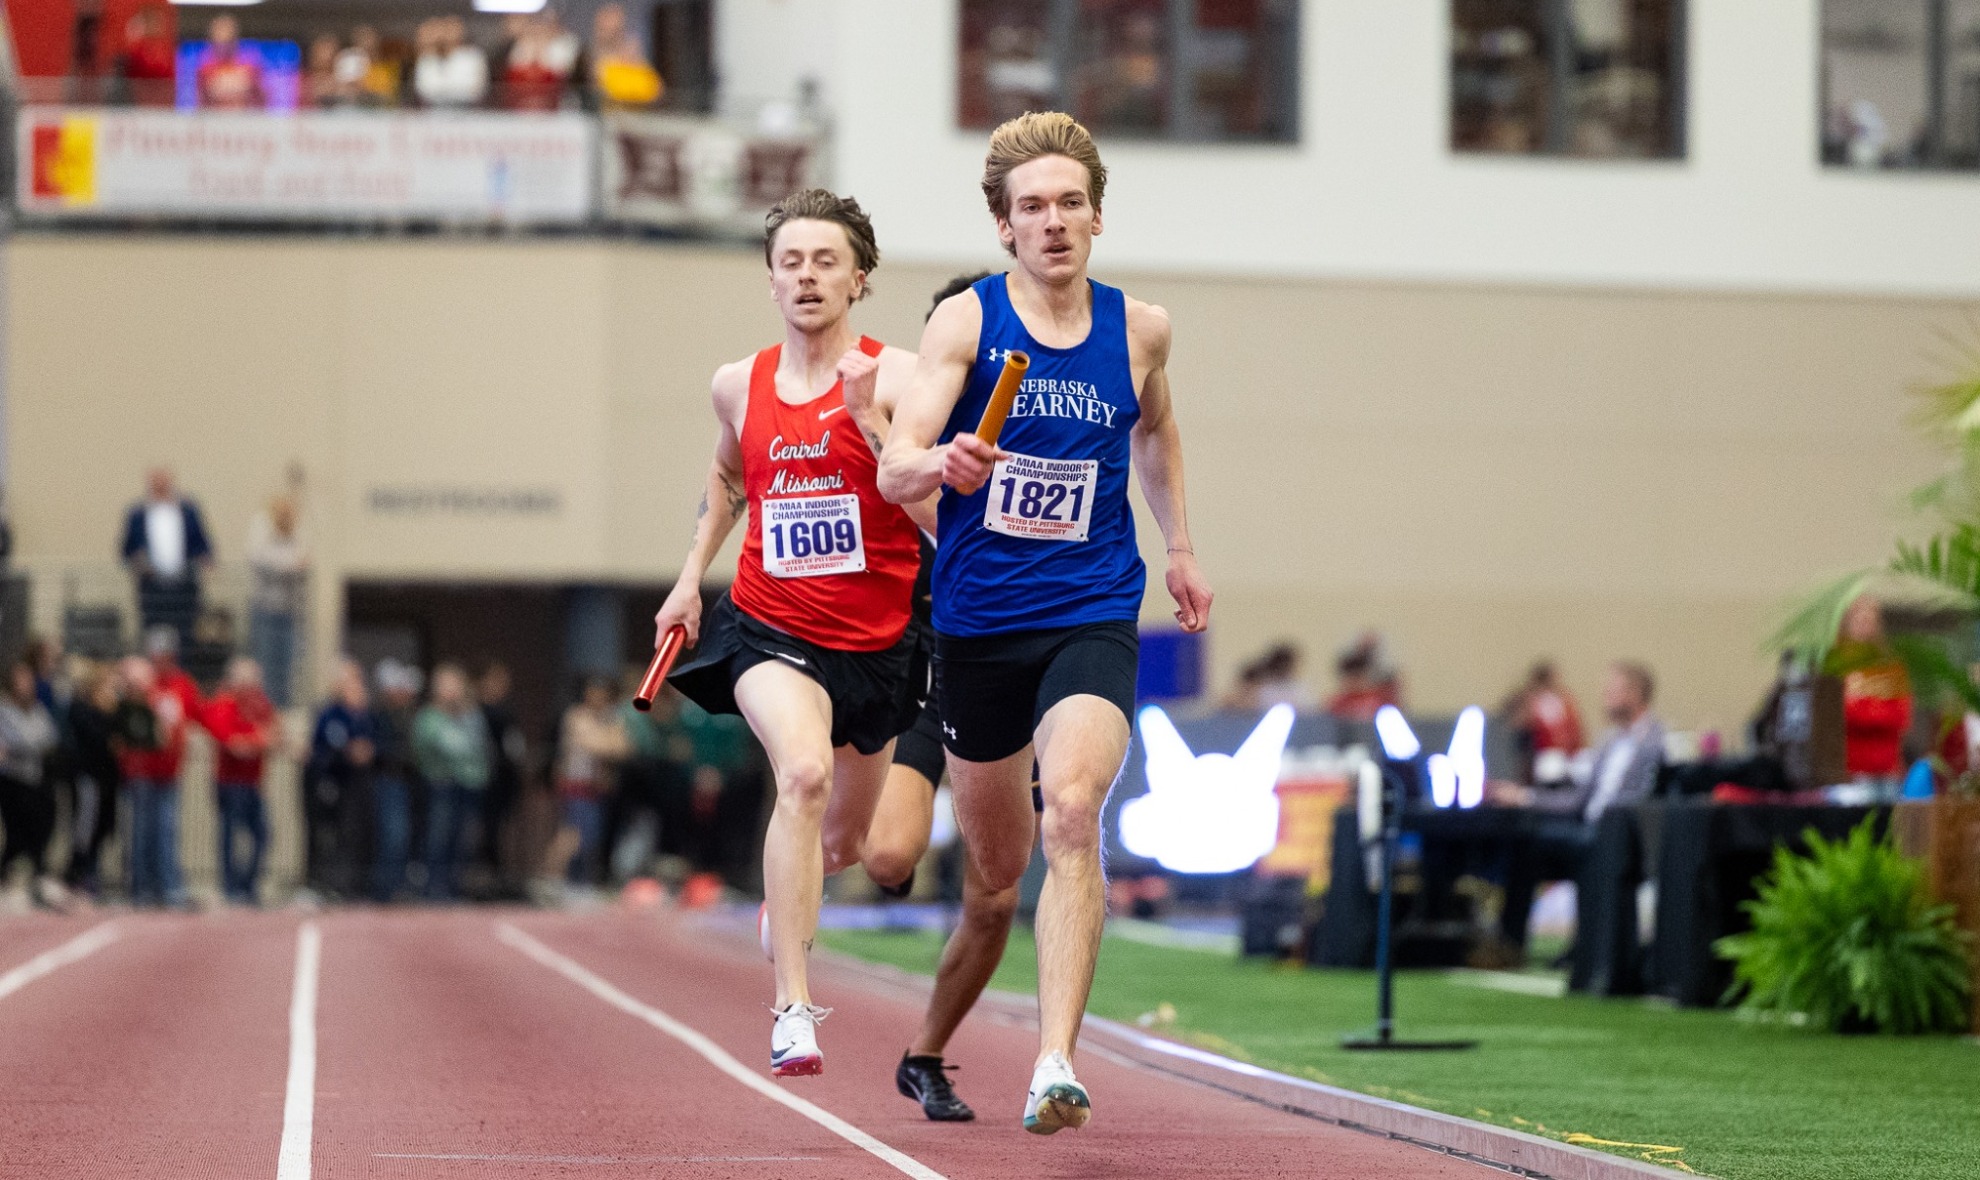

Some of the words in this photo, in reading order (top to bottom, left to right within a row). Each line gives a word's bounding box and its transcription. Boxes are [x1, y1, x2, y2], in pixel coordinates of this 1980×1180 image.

[1017, 379, 1098, 399] NEBRASKA
[1007, 394, 1117, 428] EARNEY
[769, 430, 830, 461] Central
[1006, 465, 1088, 482] CHAMPIONSHIPS
[1016, 458, 1043, 470] MIAA
[1047, 463, 1081, 472] INDOOR
[767, 469, 844, 494] Missouri
[779, 502, 802, 510] MIAA
[805, 500, 841, 509] INDOOR
[1000, 477, 1085, 522] 1821
[773, 508, 850, 520] CHAMPIONSHIPS
[1002, 515, 1028, 525] HOSTED
[1040, 521, 1075, 529] PITTSBURG
[1007, 524, 1028, 532] STATE
[770, 519, 856, 558] 1609
